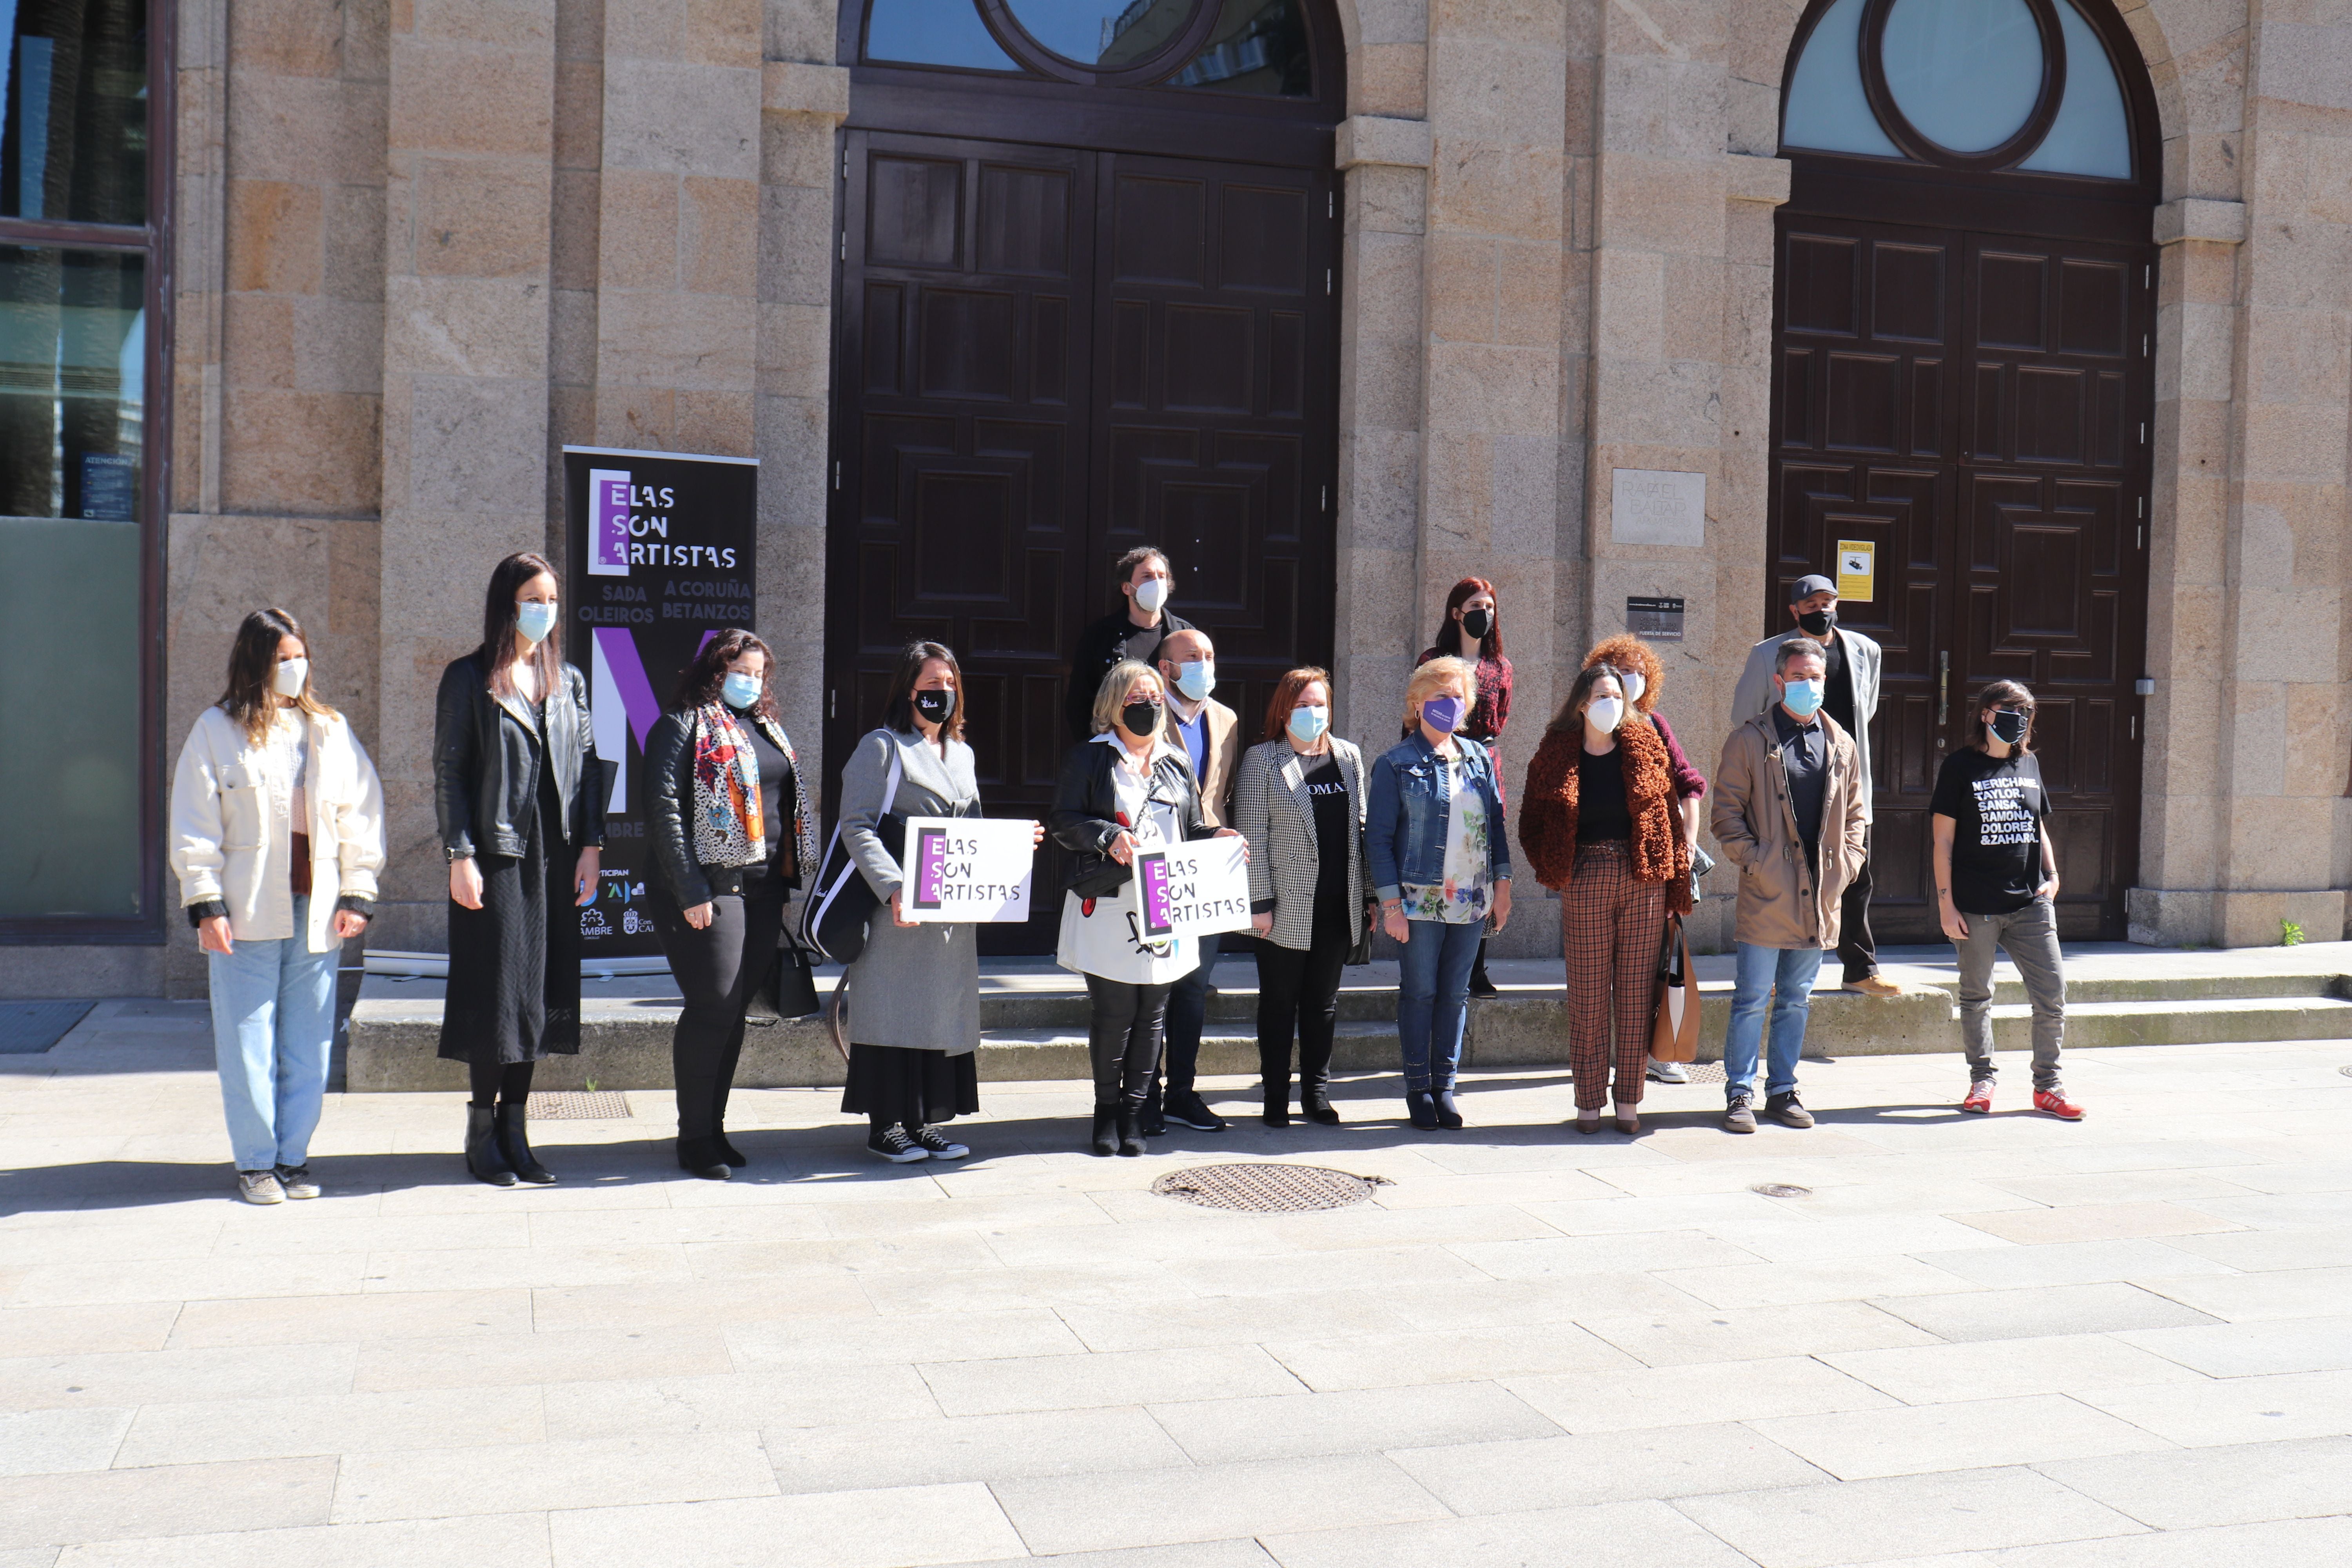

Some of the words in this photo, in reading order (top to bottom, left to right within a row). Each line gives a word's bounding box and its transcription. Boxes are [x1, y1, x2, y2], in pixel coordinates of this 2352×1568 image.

[611, 484, 675, 508] ELAS
[1622, 481, 1684, 500] RAFAEL
[1630, 499, 1686, 517] BALTAR
[611, 514, 667, 538] SON
[613, 542, 736, 568] ARTISTAS
[602, 585, 647, 602] SADA
[664, 581, 676, 595] A
[679, 579, 751, 599] CORUÑA
[578, 606, 654, 623] OLEIROS
[662, 602, 750, 620] BETANZOS
[1973, 788, 2025, 800] TAYLOR,
[1978, 800, 2022, 812] SANSA,
[1980, 810, 2034, 822] RAMONA,
[1981, 821, 2036, 834] DOLORES,
[931, 838, 977, 855] ELAS
[1980, 833, 2039, 846] &ZAHARA.
[931, 862, 971, 878] SON
[1154, 859, 1198, 880] ELAS
[931, 884, 1020, 900] ARTISTAS
[1157, 882, 1195, 903] SON
[1160, 898, 1245, 925] ARTISTAS
[581, 926, 613, 936] AMBRE
